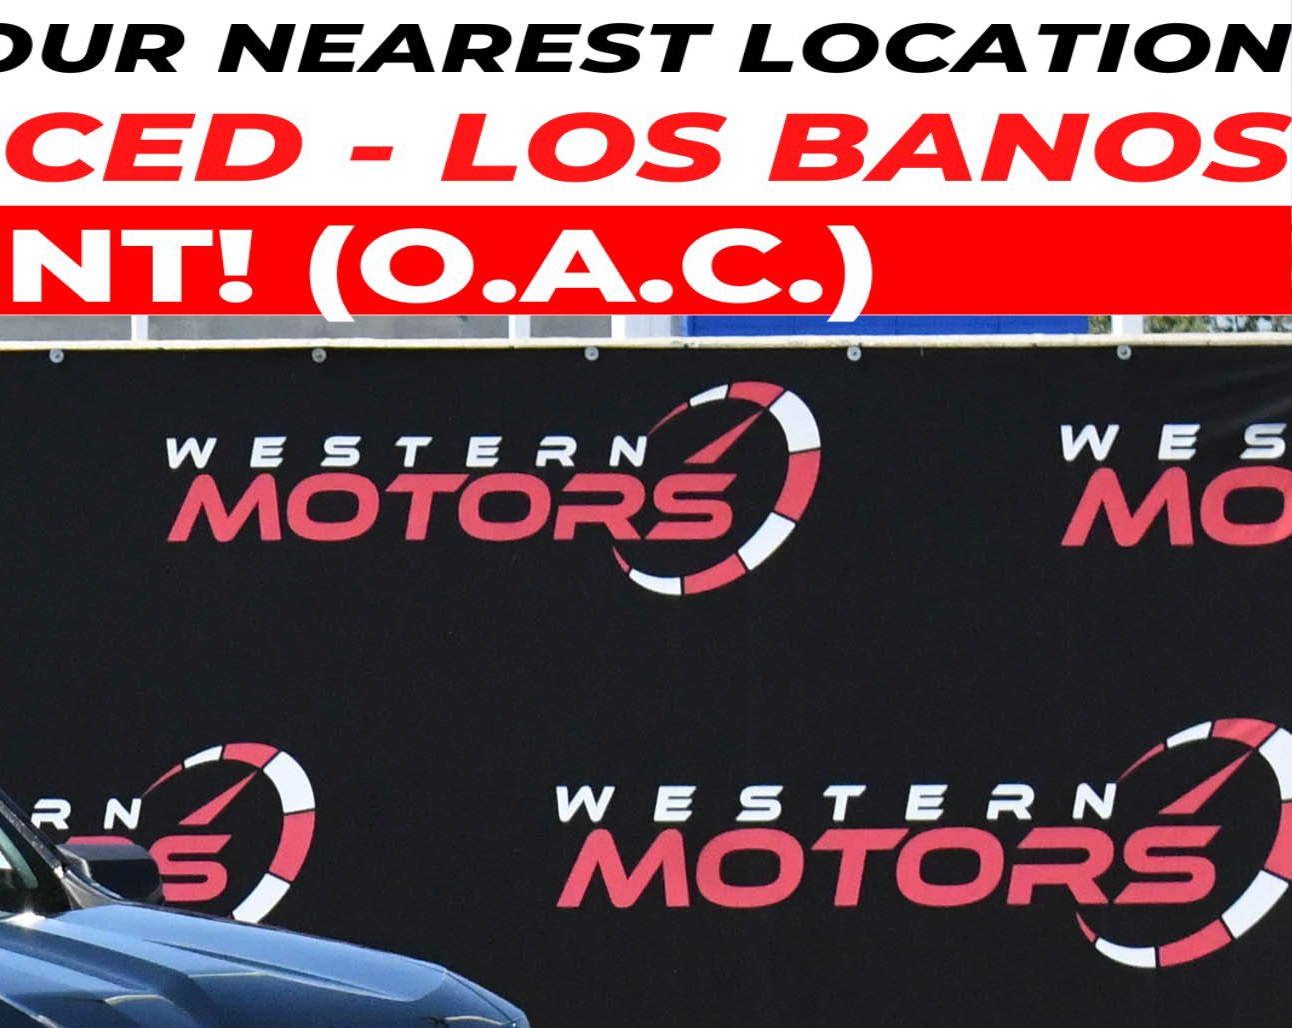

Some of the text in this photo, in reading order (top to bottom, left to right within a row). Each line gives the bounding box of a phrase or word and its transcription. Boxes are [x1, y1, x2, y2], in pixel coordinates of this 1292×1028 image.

[166, 435, 647, 469] WESTERN
[168, 472, 736, 543] MOTORS
[556, 783, 1117, 822] WESTERN
[557, 825, 1219, 909] MOTORS
